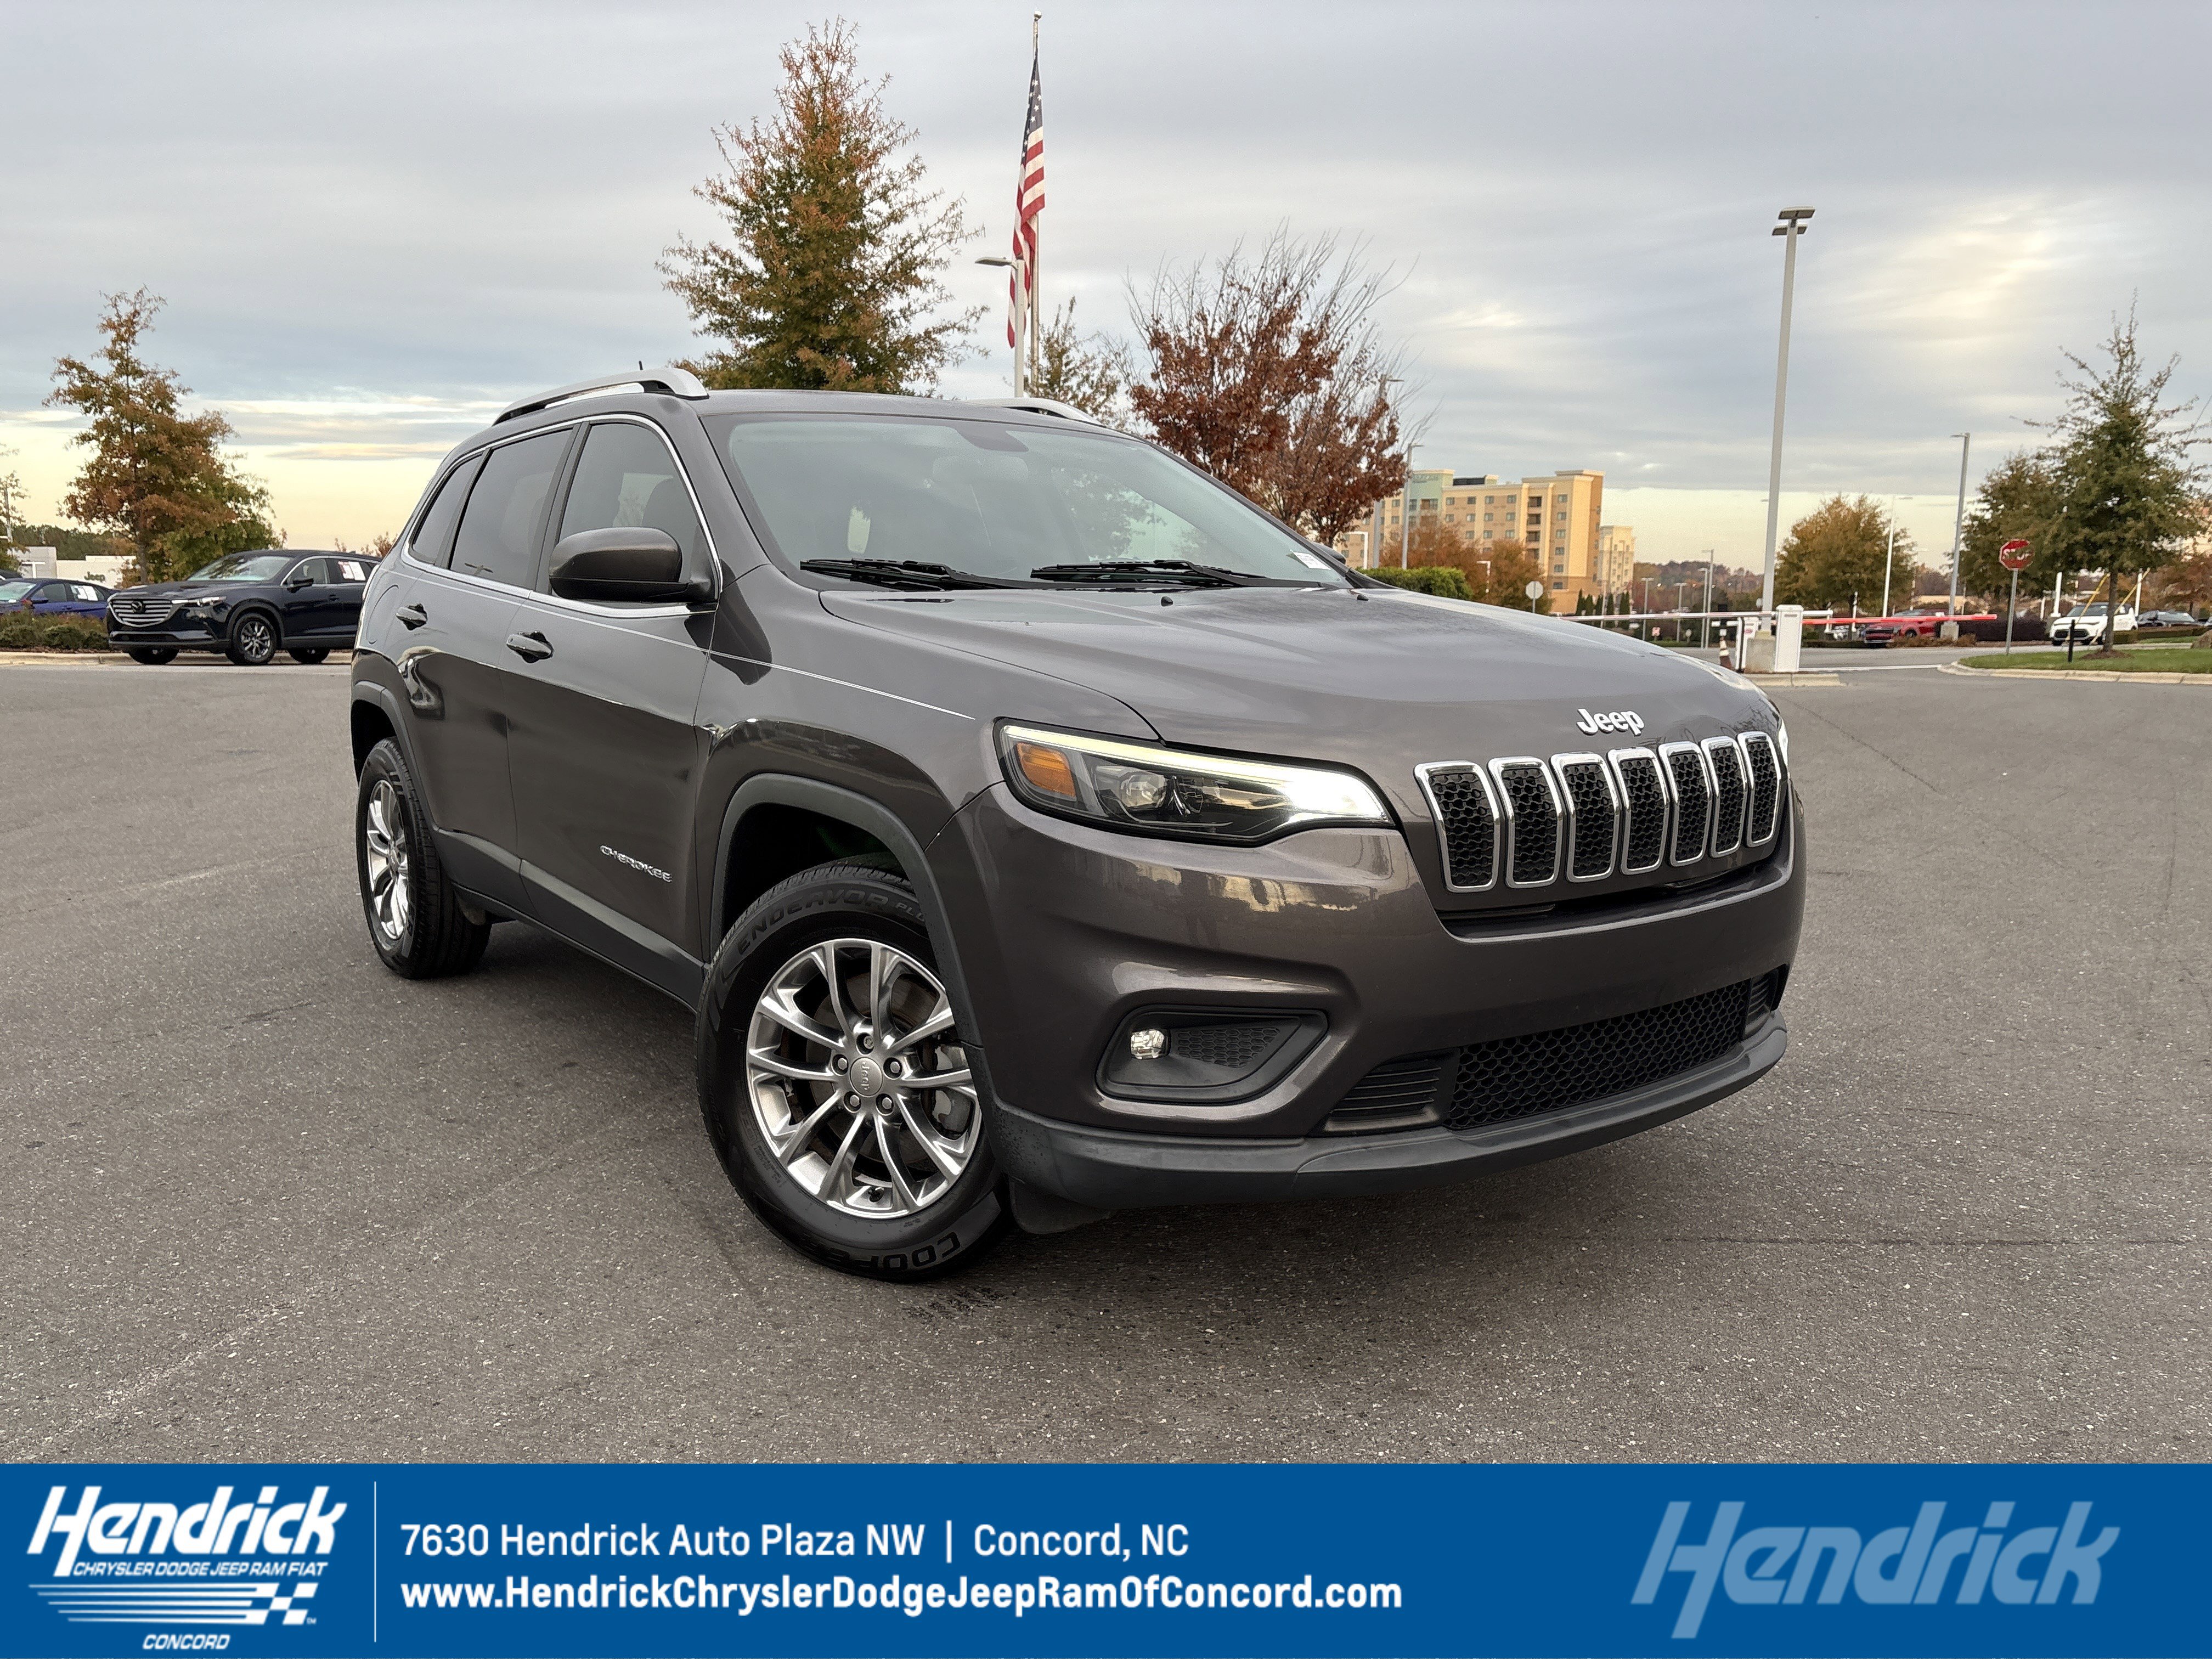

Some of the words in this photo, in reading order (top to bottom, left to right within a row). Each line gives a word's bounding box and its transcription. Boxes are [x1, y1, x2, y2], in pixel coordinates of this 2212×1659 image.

[84, 571, 105, 583] Jeep
[1576, 708, 1645, 736] Jeep
[600, 845, 673, 883] CHEROKEE
[895, 902, 926, 922] PLU
[861, 1062, 870, 1090] Jeep
